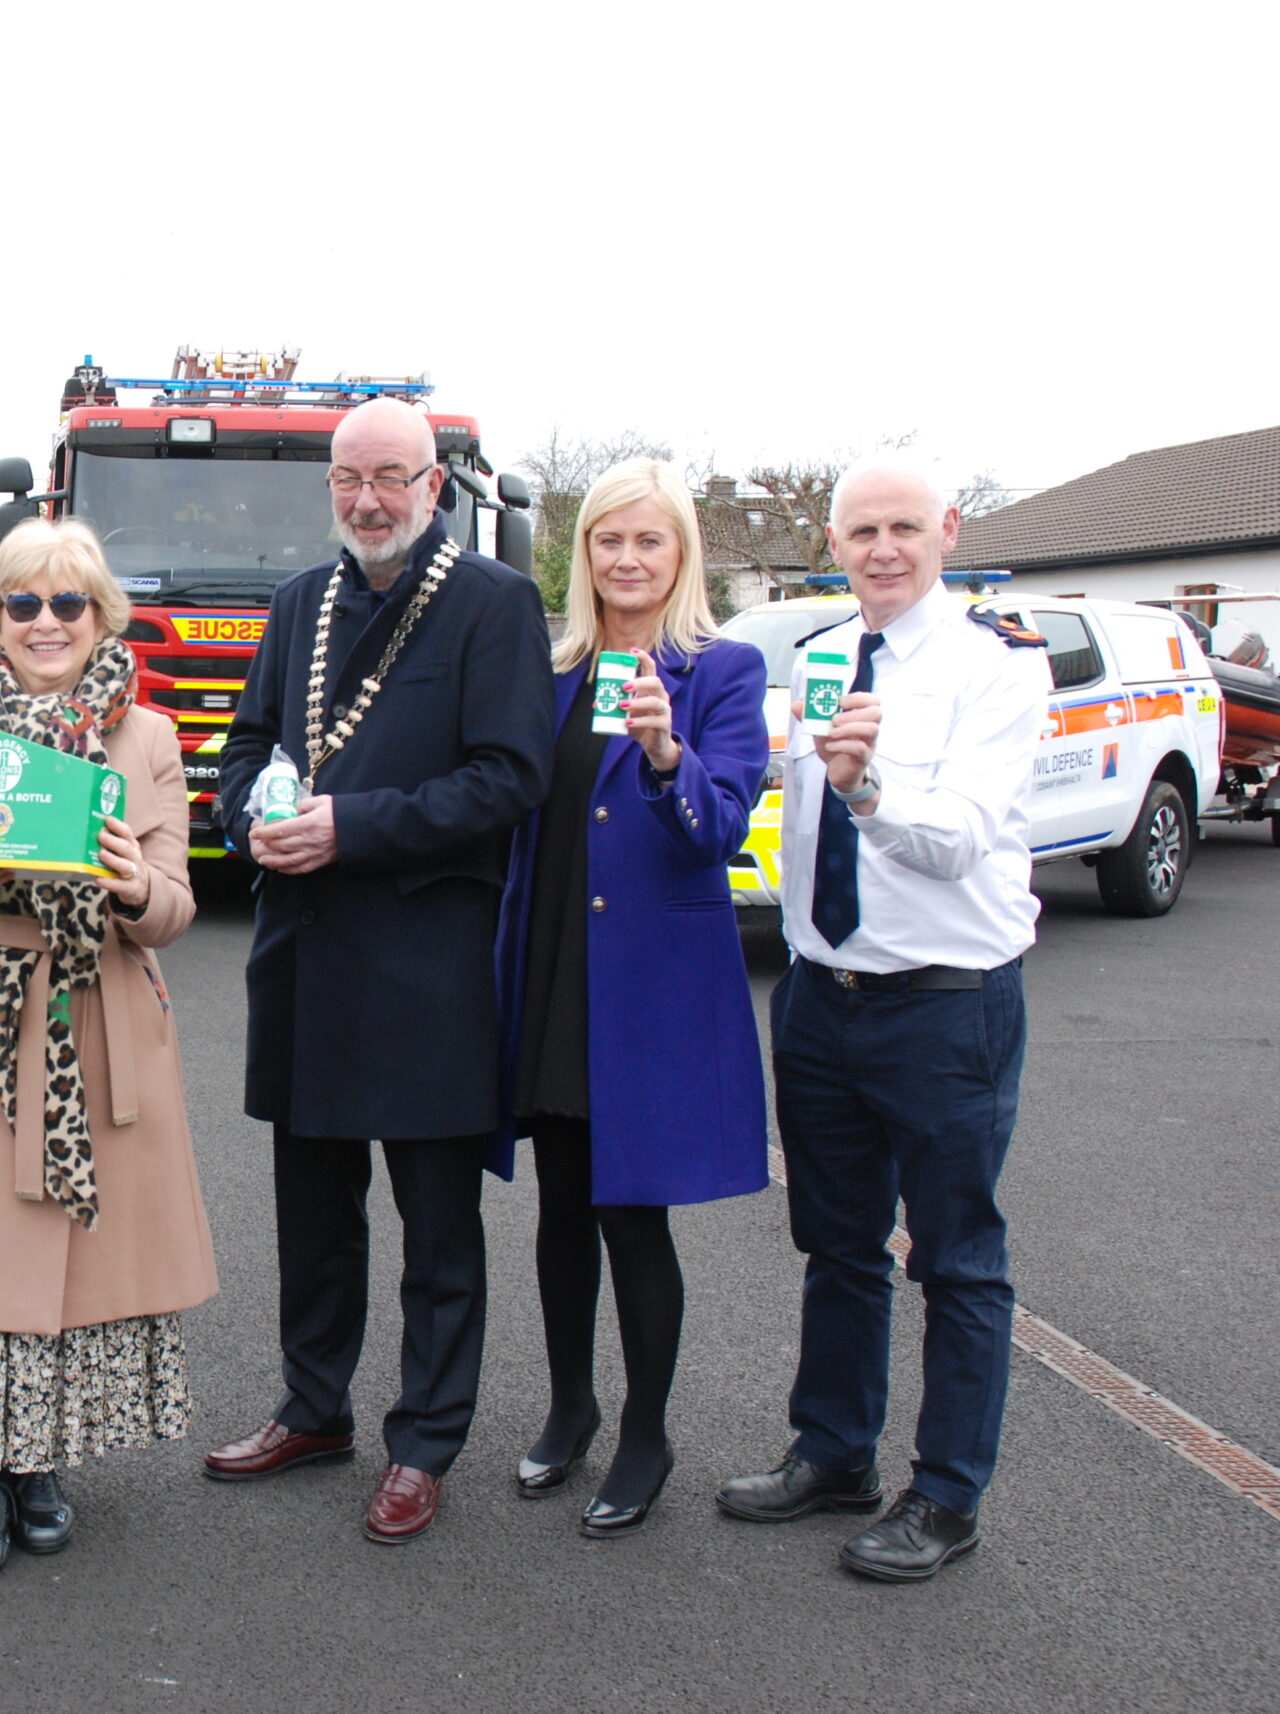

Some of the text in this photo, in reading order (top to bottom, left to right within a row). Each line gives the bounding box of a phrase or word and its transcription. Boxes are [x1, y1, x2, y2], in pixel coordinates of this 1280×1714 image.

[1033, 748, 1093, 776] IVIL DEFENCE
[184, 767, 220, 779] 320
[7, 792, 14, 801] A
[15, 793, 52, 803] BOTTLE
